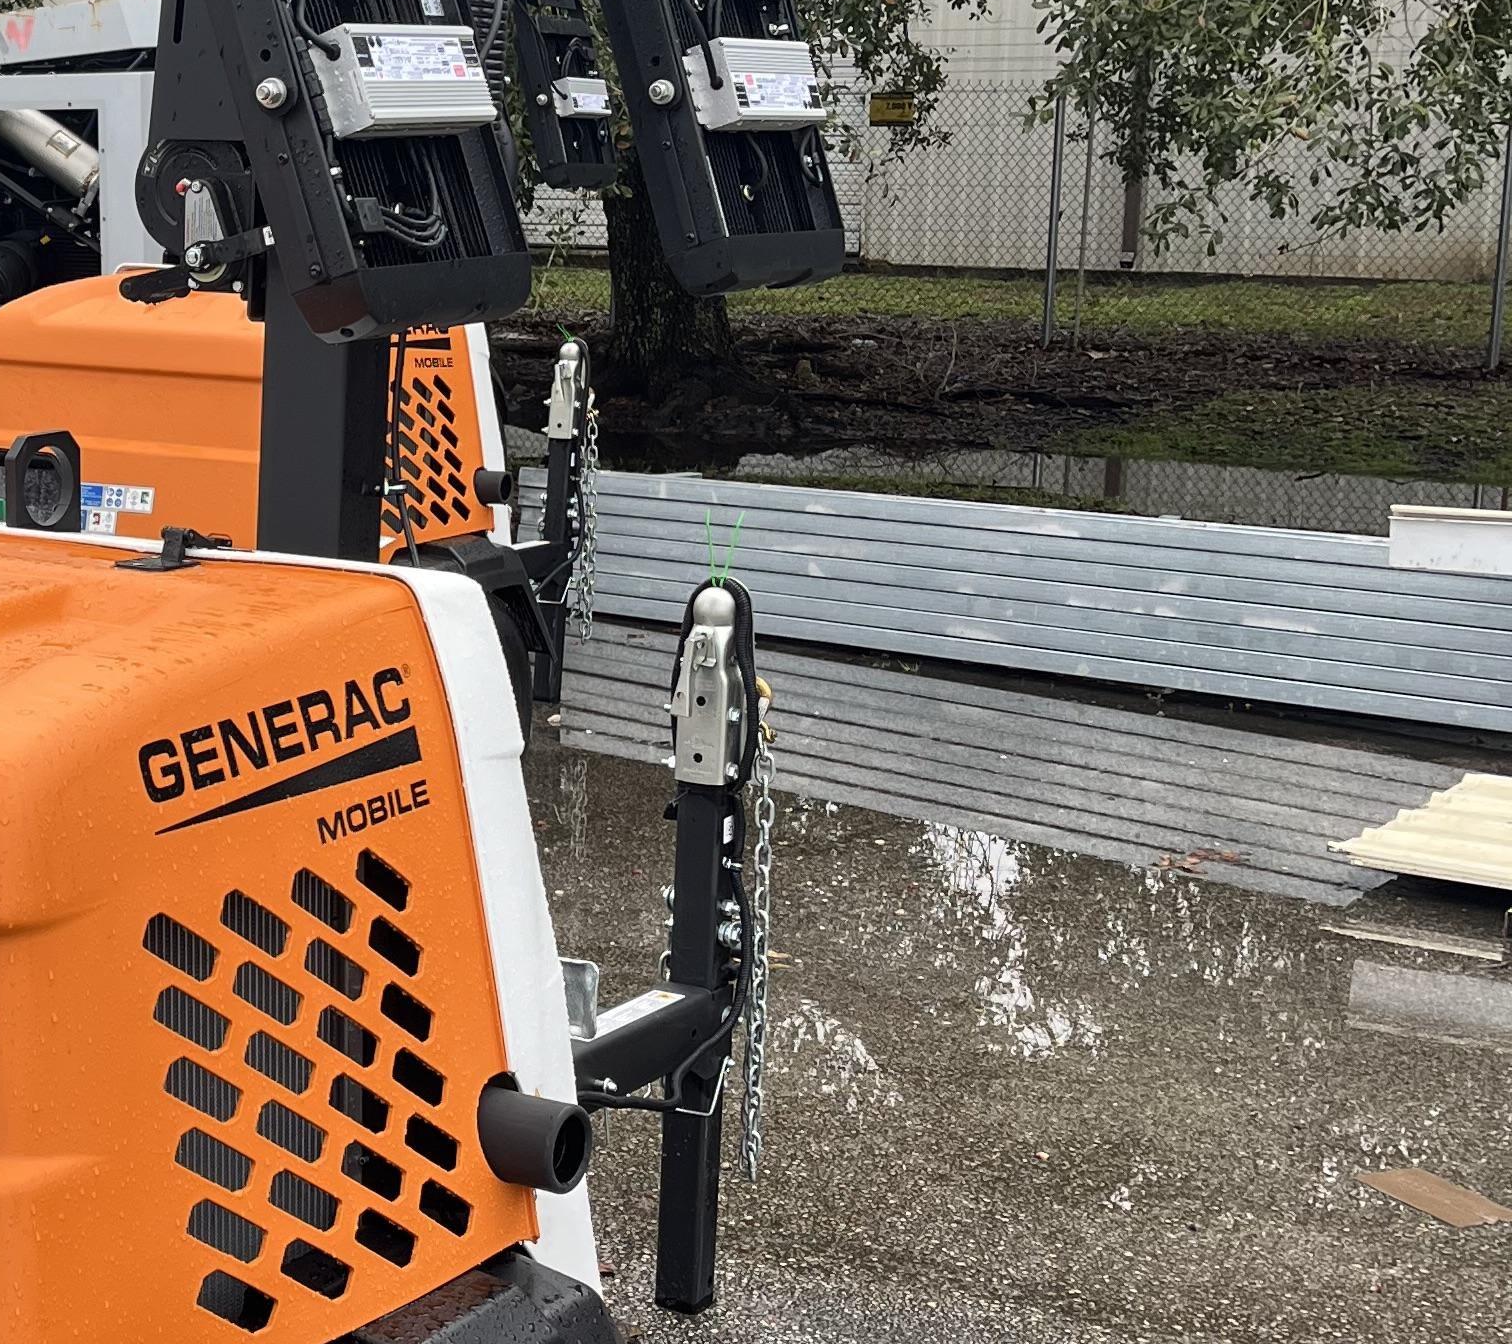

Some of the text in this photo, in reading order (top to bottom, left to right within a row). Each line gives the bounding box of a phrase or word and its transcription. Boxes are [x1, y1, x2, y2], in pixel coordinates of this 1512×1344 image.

[414, 357, 454, 368] MOBILE
[138, 667, 412, 803] GENERAC
[317, 779, 430, 844] MOBILE
